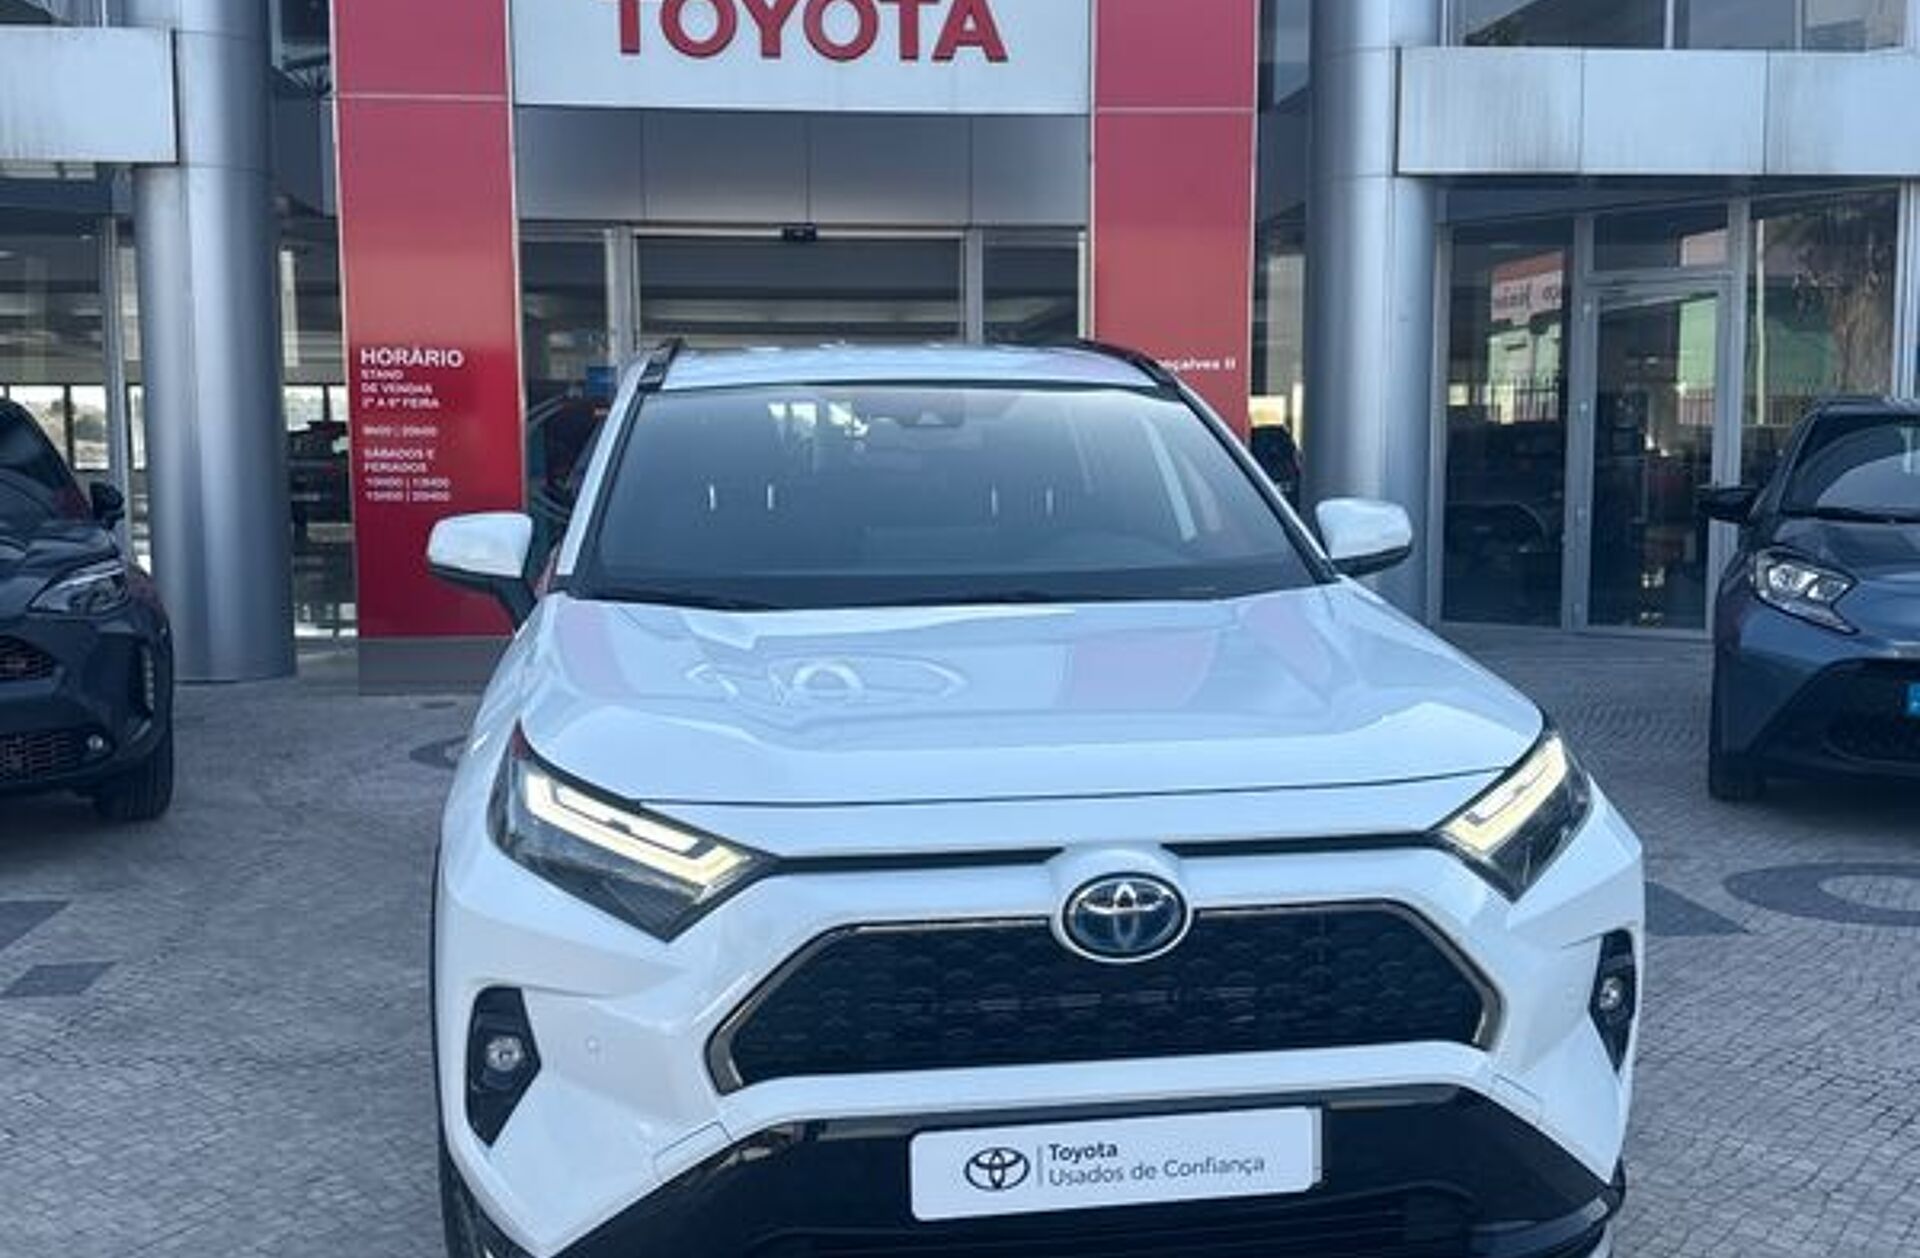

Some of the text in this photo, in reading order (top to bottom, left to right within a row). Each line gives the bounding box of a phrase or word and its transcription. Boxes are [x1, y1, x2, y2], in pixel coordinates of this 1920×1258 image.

[619, 0, 1008, 62] TOYOTA
[360, 347, 465, 367] HORÁRIO
[360, 369, 403, 380] STAND
[361, 382, 433, 394] DE VENDAS
[364, 462, 427, 473] FERIADOS
[1049, 1143, 1118, 1163] Toyota
[1049, 1156, 1265, 1186] Usados de Confiança
